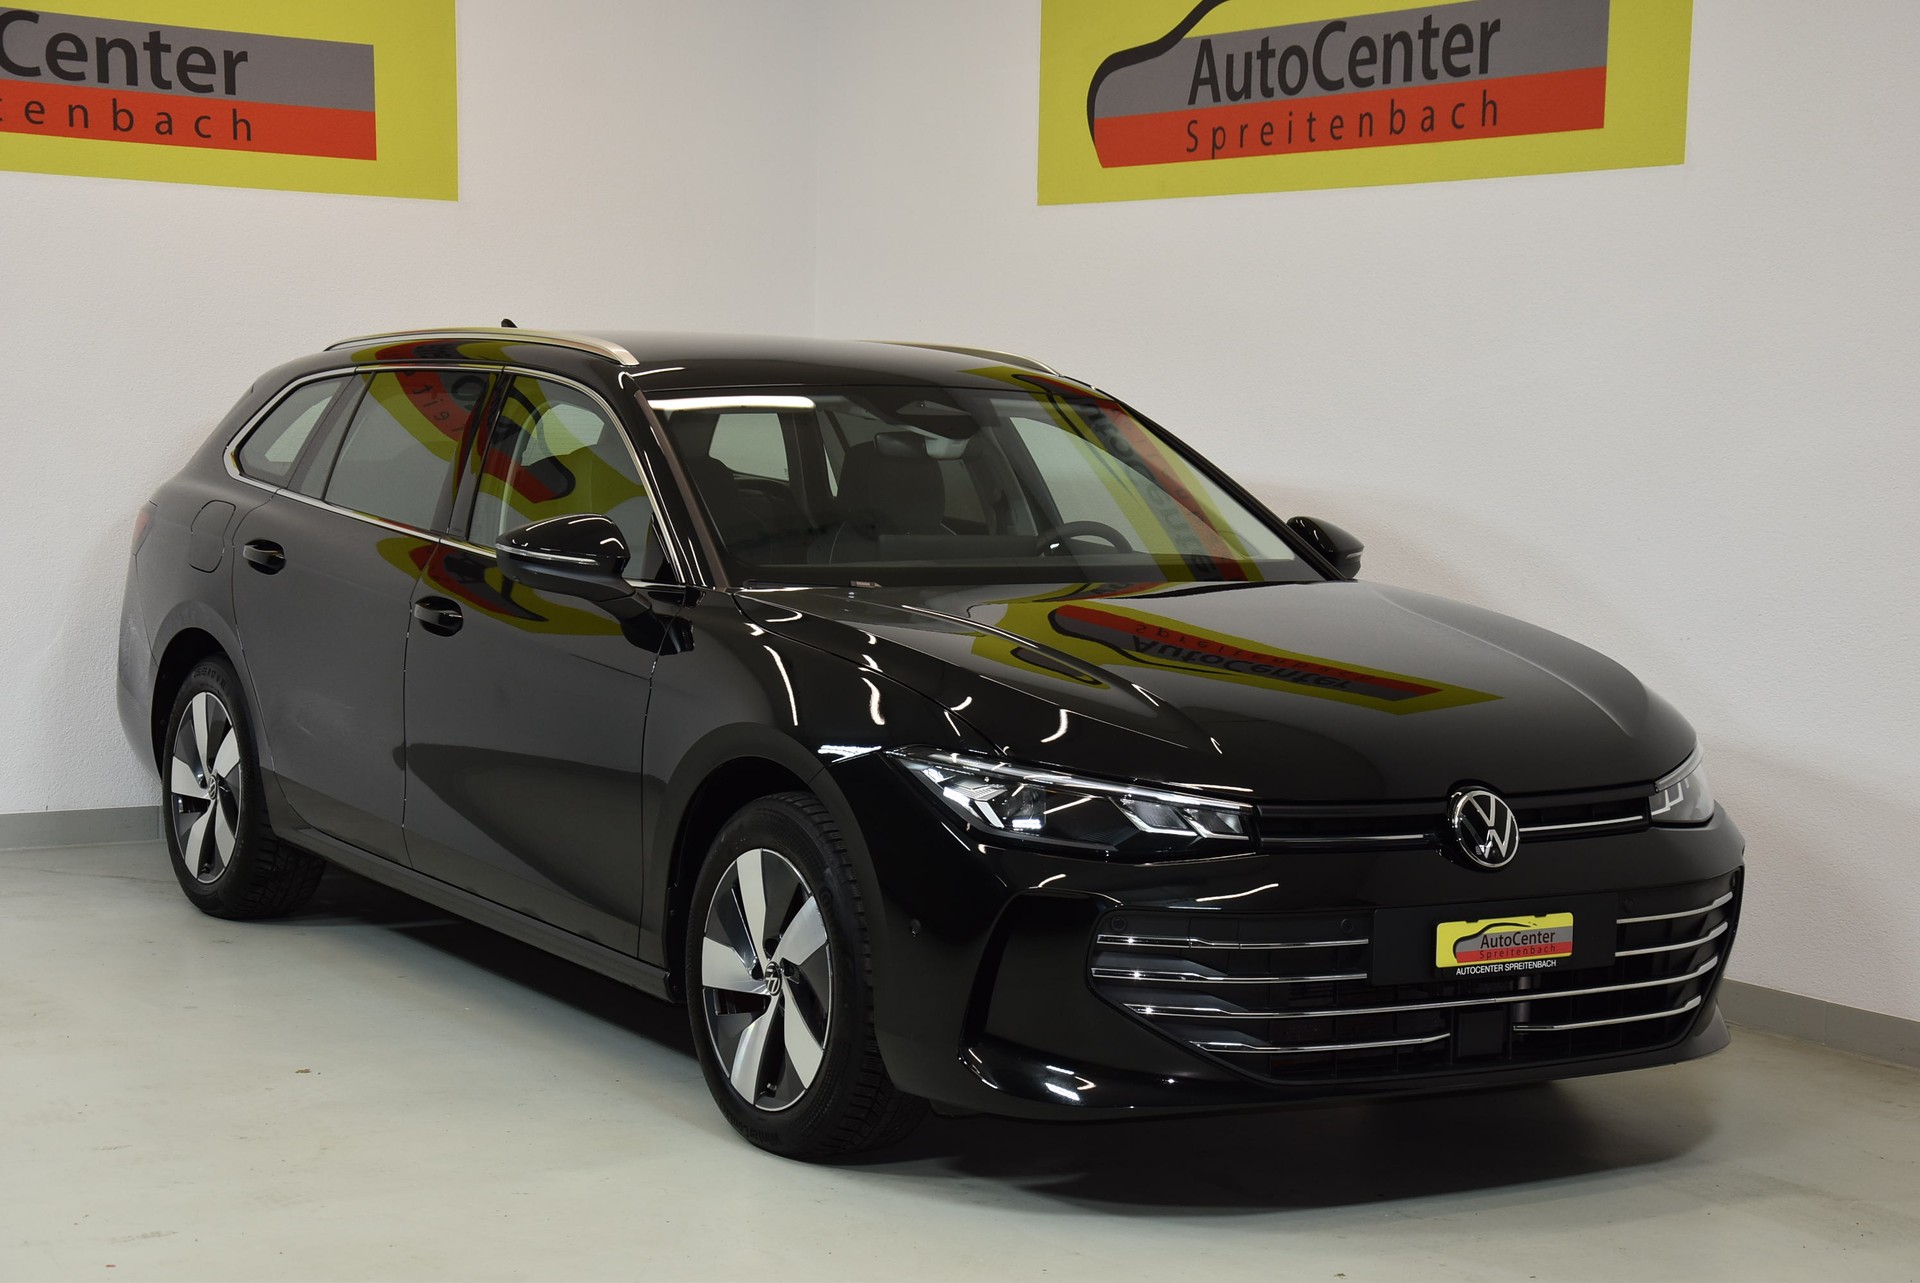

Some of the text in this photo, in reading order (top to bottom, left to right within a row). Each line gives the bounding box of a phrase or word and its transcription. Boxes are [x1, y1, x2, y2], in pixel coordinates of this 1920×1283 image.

[1187, 14, 1500, 106] AutoCenter
[0, 97, 252, 142] enbach
[1185, 90, 1498, 160] Spreitenbach
[1479, 944, 1556, 960] Spreitenbach
[1480, 931, 1555, 949] AutoCenter
[1456, 959, 1557, 976] AUTOCENTER SPREITENBACH
